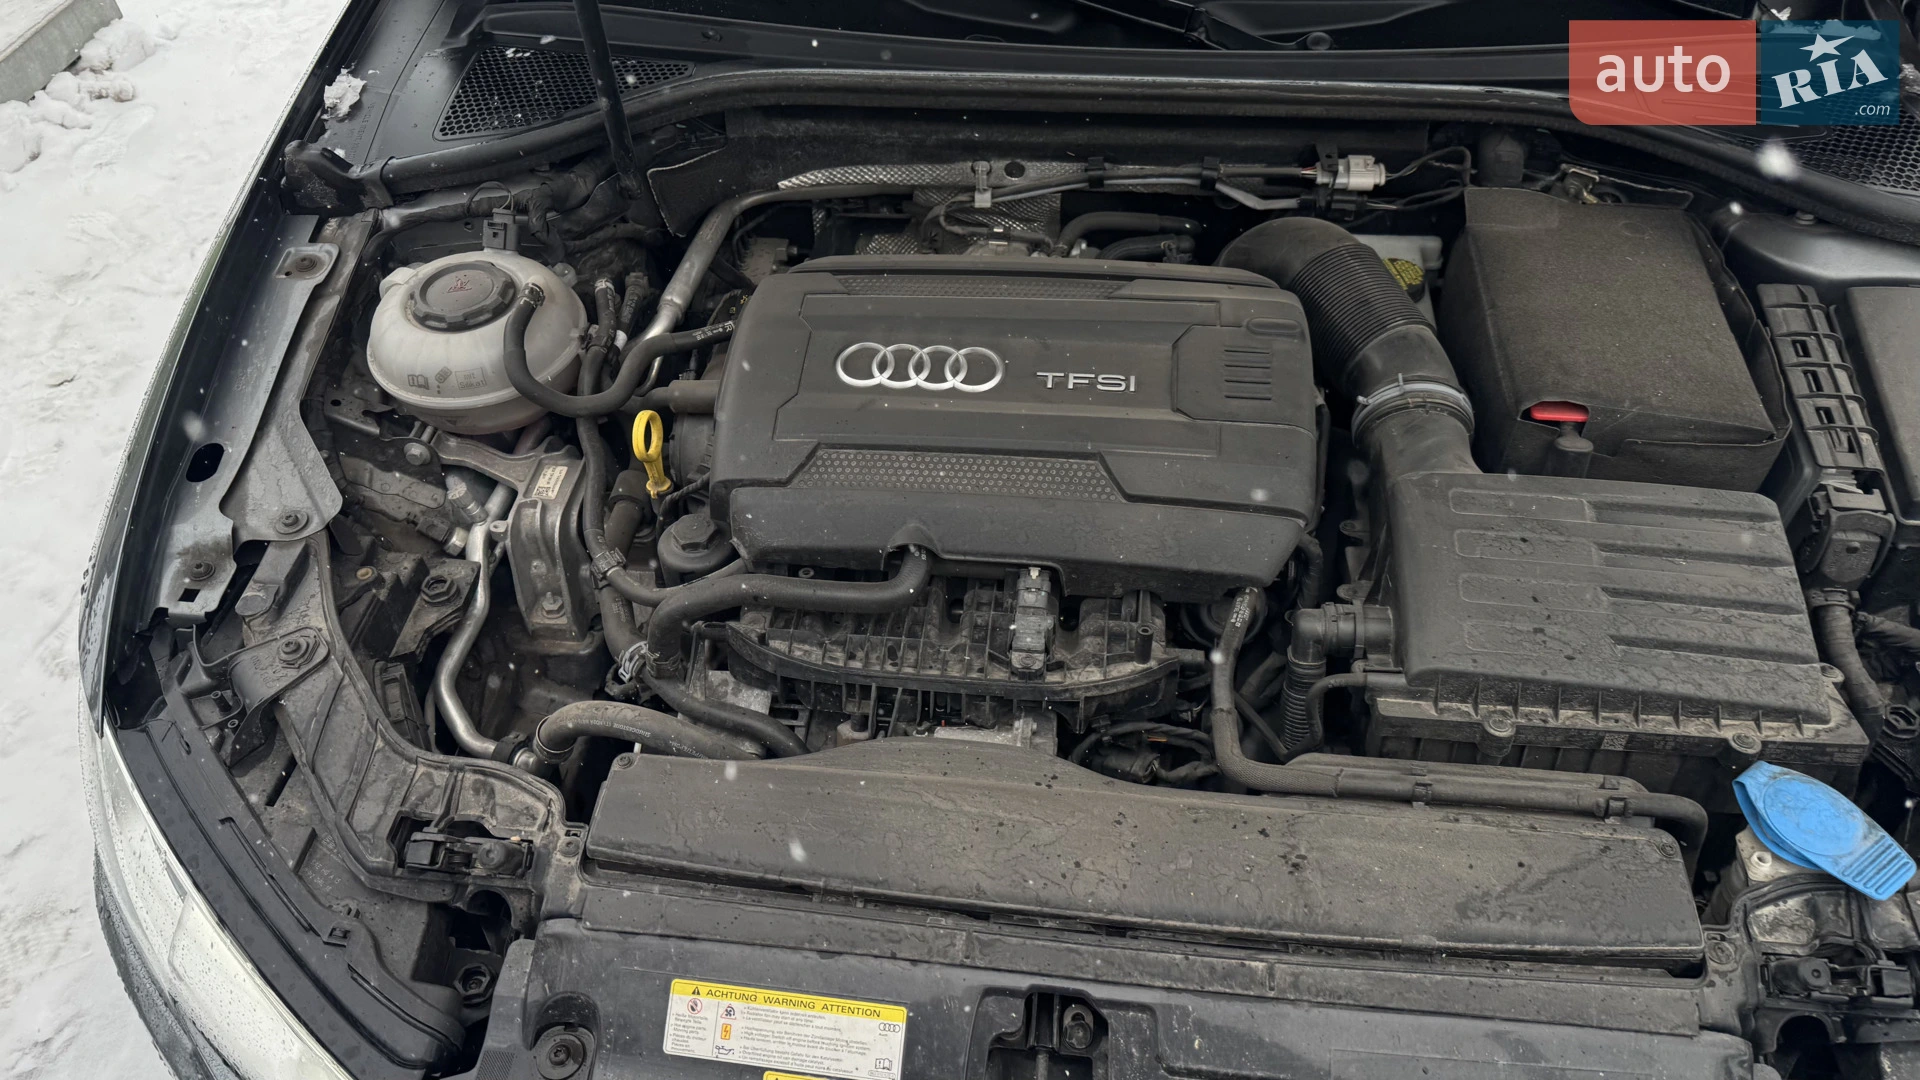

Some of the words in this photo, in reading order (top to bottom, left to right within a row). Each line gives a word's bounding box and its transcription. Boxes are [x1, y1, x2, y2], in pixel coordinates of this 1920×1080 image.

[1036, 372, 1135, 392] TFSI
[706, 989, 757, 1003] ACHTUNG
[764, 996, 815, 1010] WARNING
[822, 1004, 881, 1018] ATTENTION
